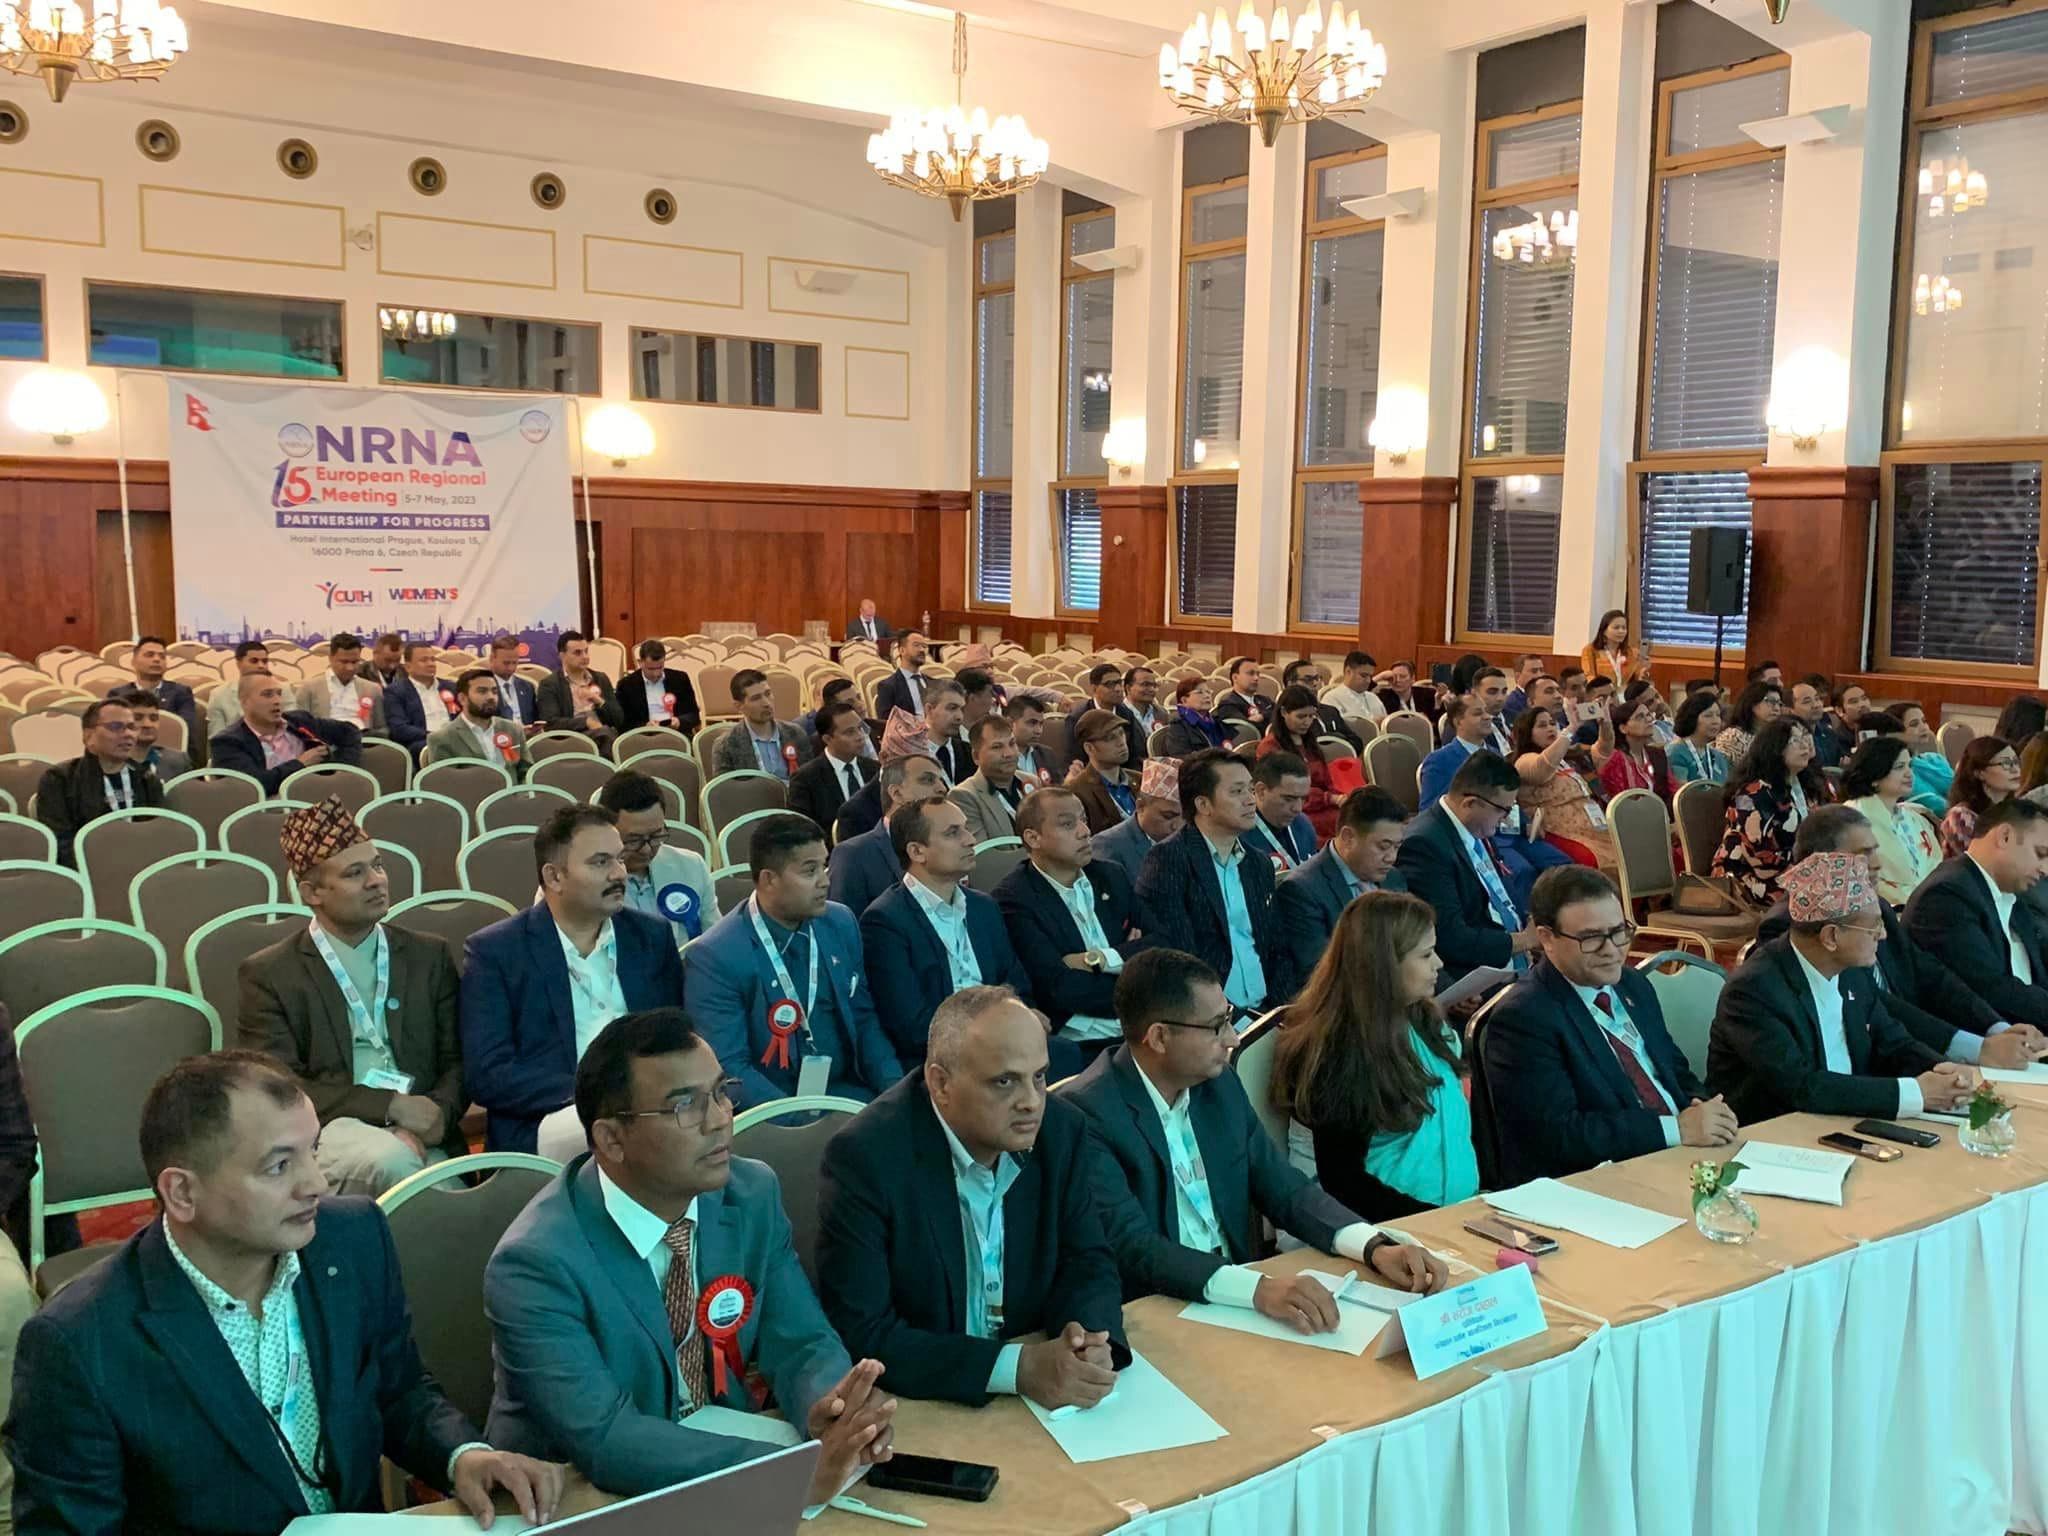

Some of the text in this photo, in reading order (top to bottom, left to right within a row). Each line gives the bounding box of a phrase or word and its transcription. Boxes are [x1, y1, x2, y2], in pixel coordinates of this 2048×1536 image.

[315, 425, 483, 467] NRNA
[316, 467, 486, 488] European Regional
[321, 487, 398, 506] Meeting
[404, 494, 476, 506] 5-7 May, 2023
[283, 514, 486, 528] PARTNERSHIP FOR PROGRESS
[289, 534, 317, 543] Hotel
[319, 535, 385, 544] International
[345, 547, 375, 557] Praha
[388, 548, 418, 557] Czech
[421, 548, 463, 558] Republic
